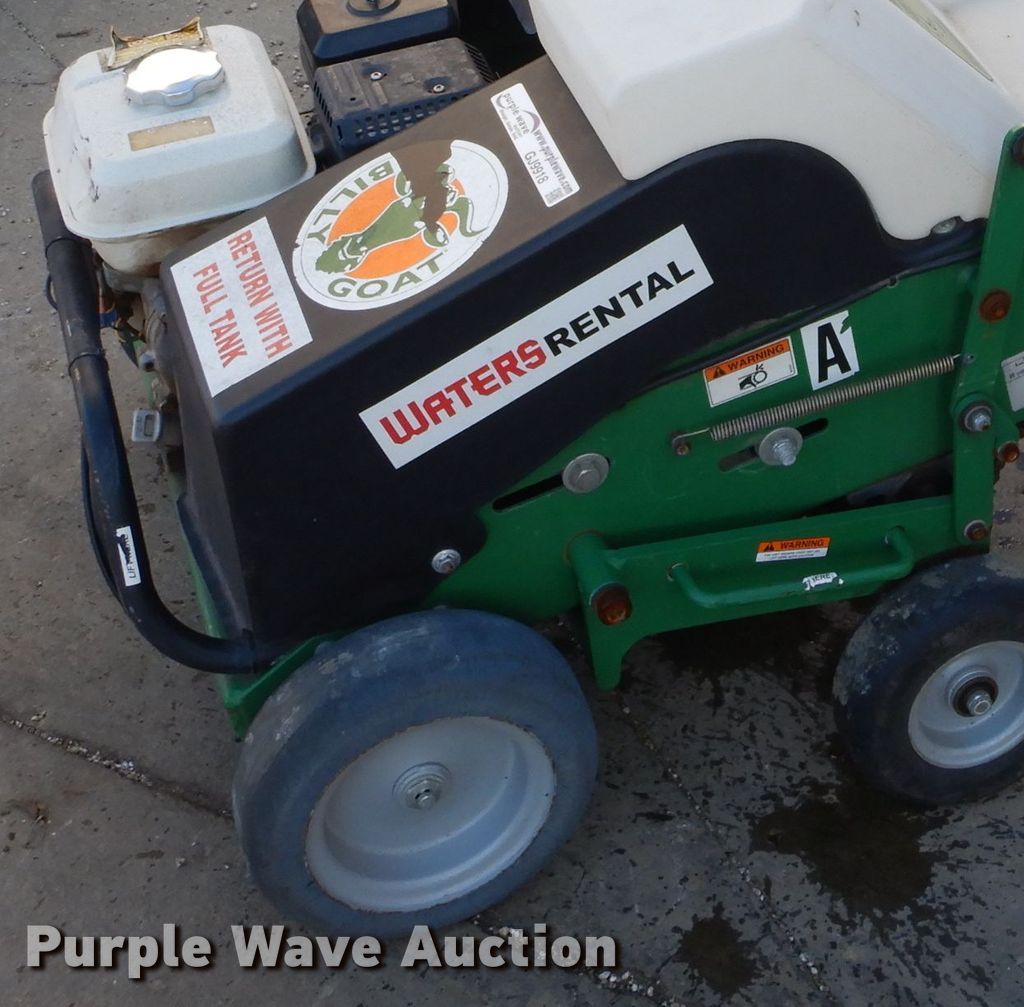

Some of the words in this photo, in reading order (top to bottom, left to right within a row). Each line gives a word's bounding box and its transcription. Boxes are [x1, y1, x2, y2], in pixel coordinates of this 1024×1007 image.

[307, 160, 394, 244] BILLY
[193, 262, 228, 315] FULL
[227, 229, 275, 308] RETURN
[254, 302, 293, 360] WITH
[327, 252, 444, 299] GOAT
[208, 308, 248, 368] TANK
[727, 343, 785, 372] WARNING
[817, 322, 852, 383] A
[780, 539, 824, 549] WARNING
